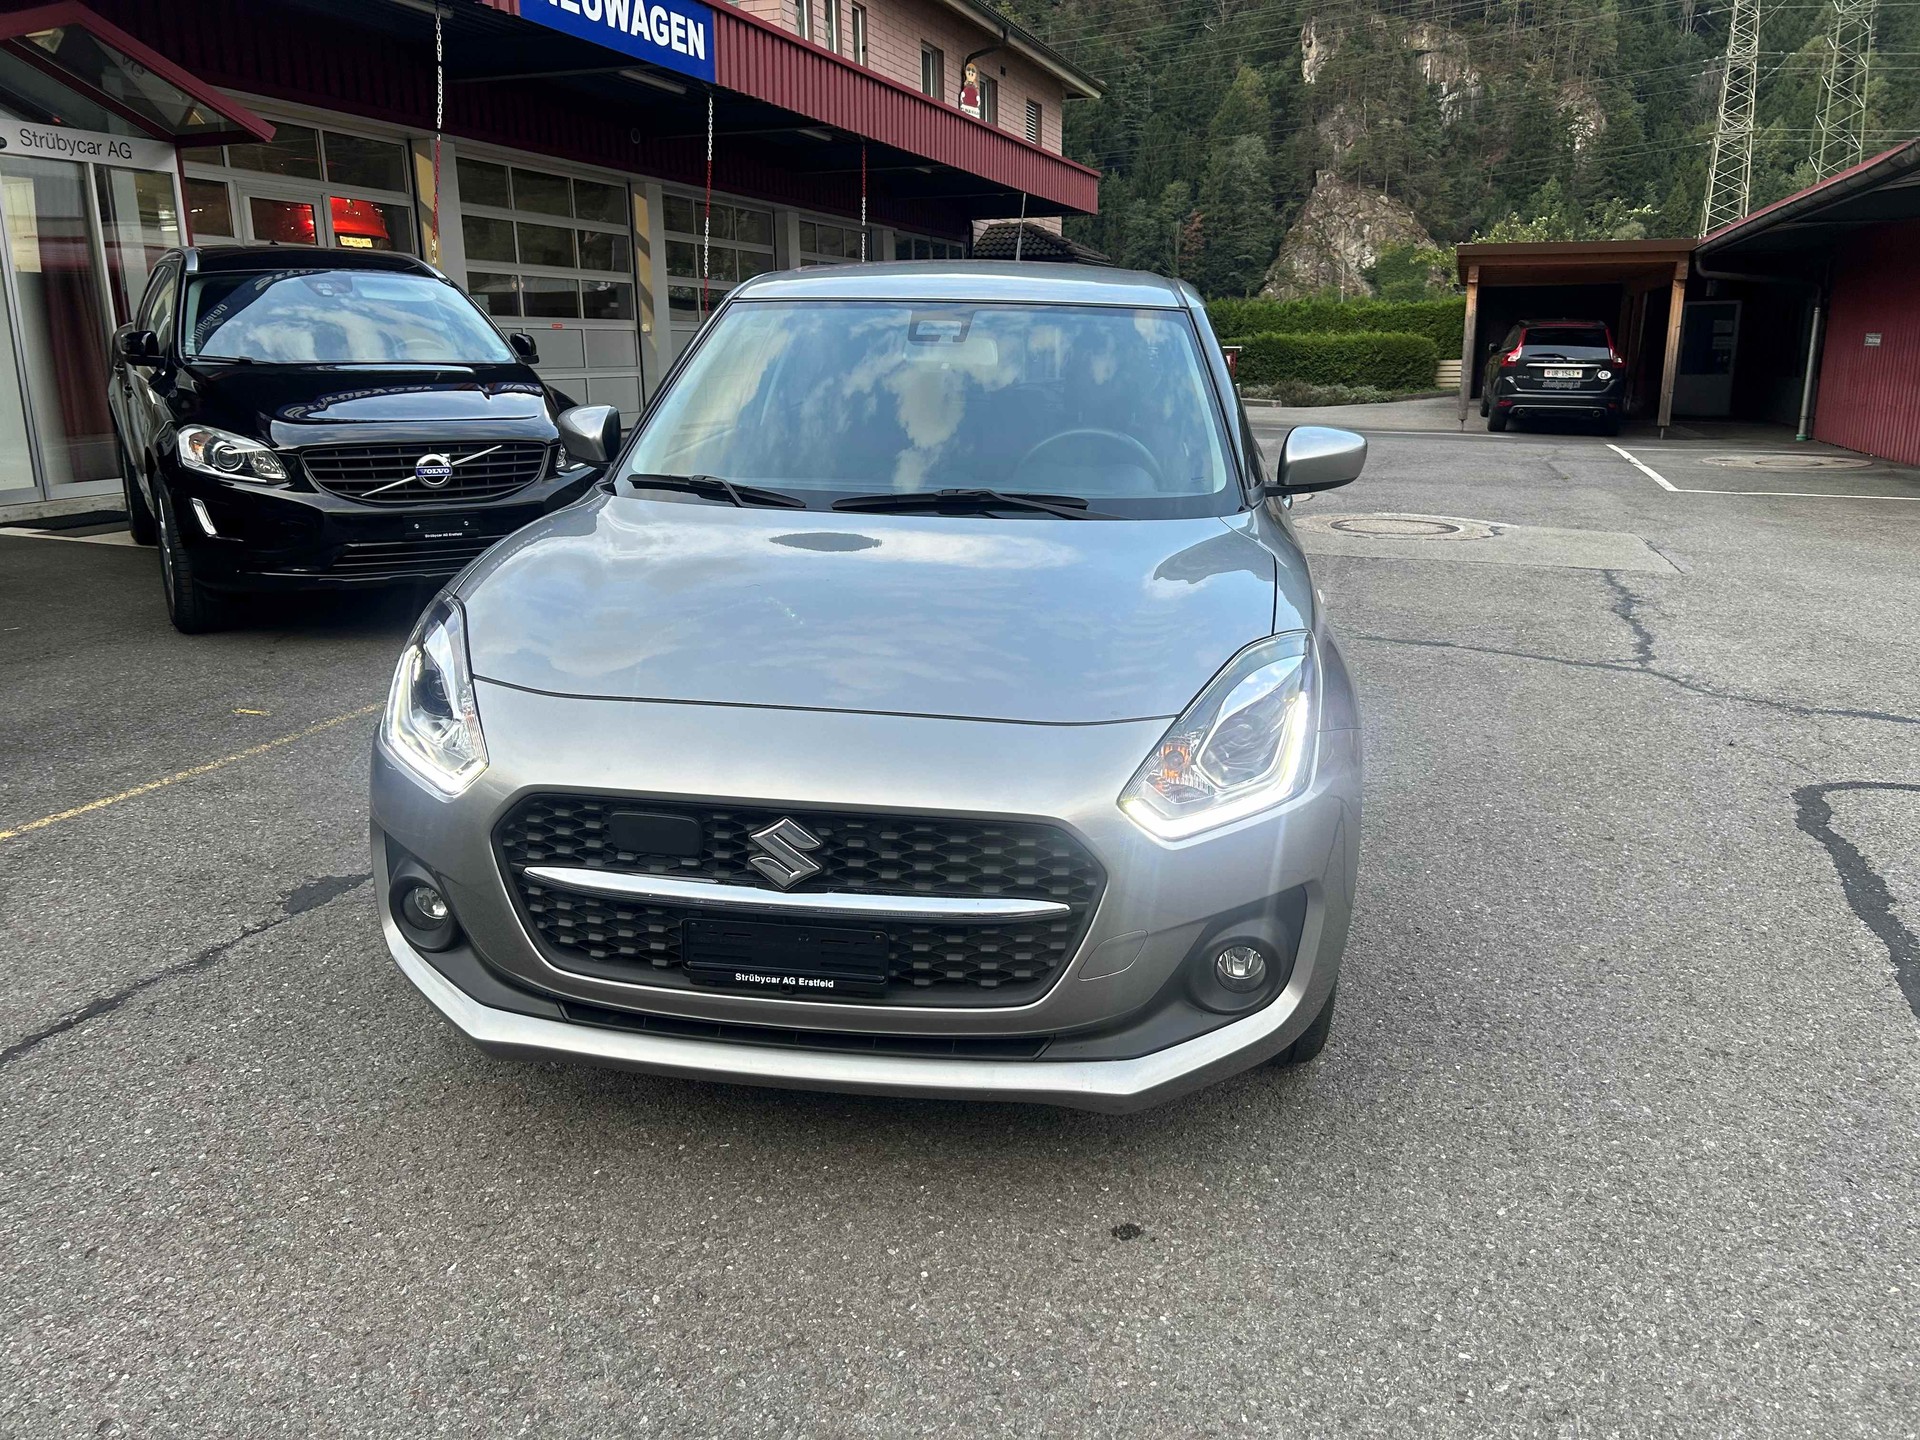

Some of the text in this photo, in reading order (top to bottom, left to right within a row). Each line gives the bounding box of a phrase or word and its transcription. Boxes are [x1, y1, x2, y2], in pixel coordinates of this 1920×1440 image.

[549, 0, 705, 60] UWAGEN
[20, 128, 133, 159] Strübycar AG
[735, 972, 834, 988] Strübycar AG Erstfeld
